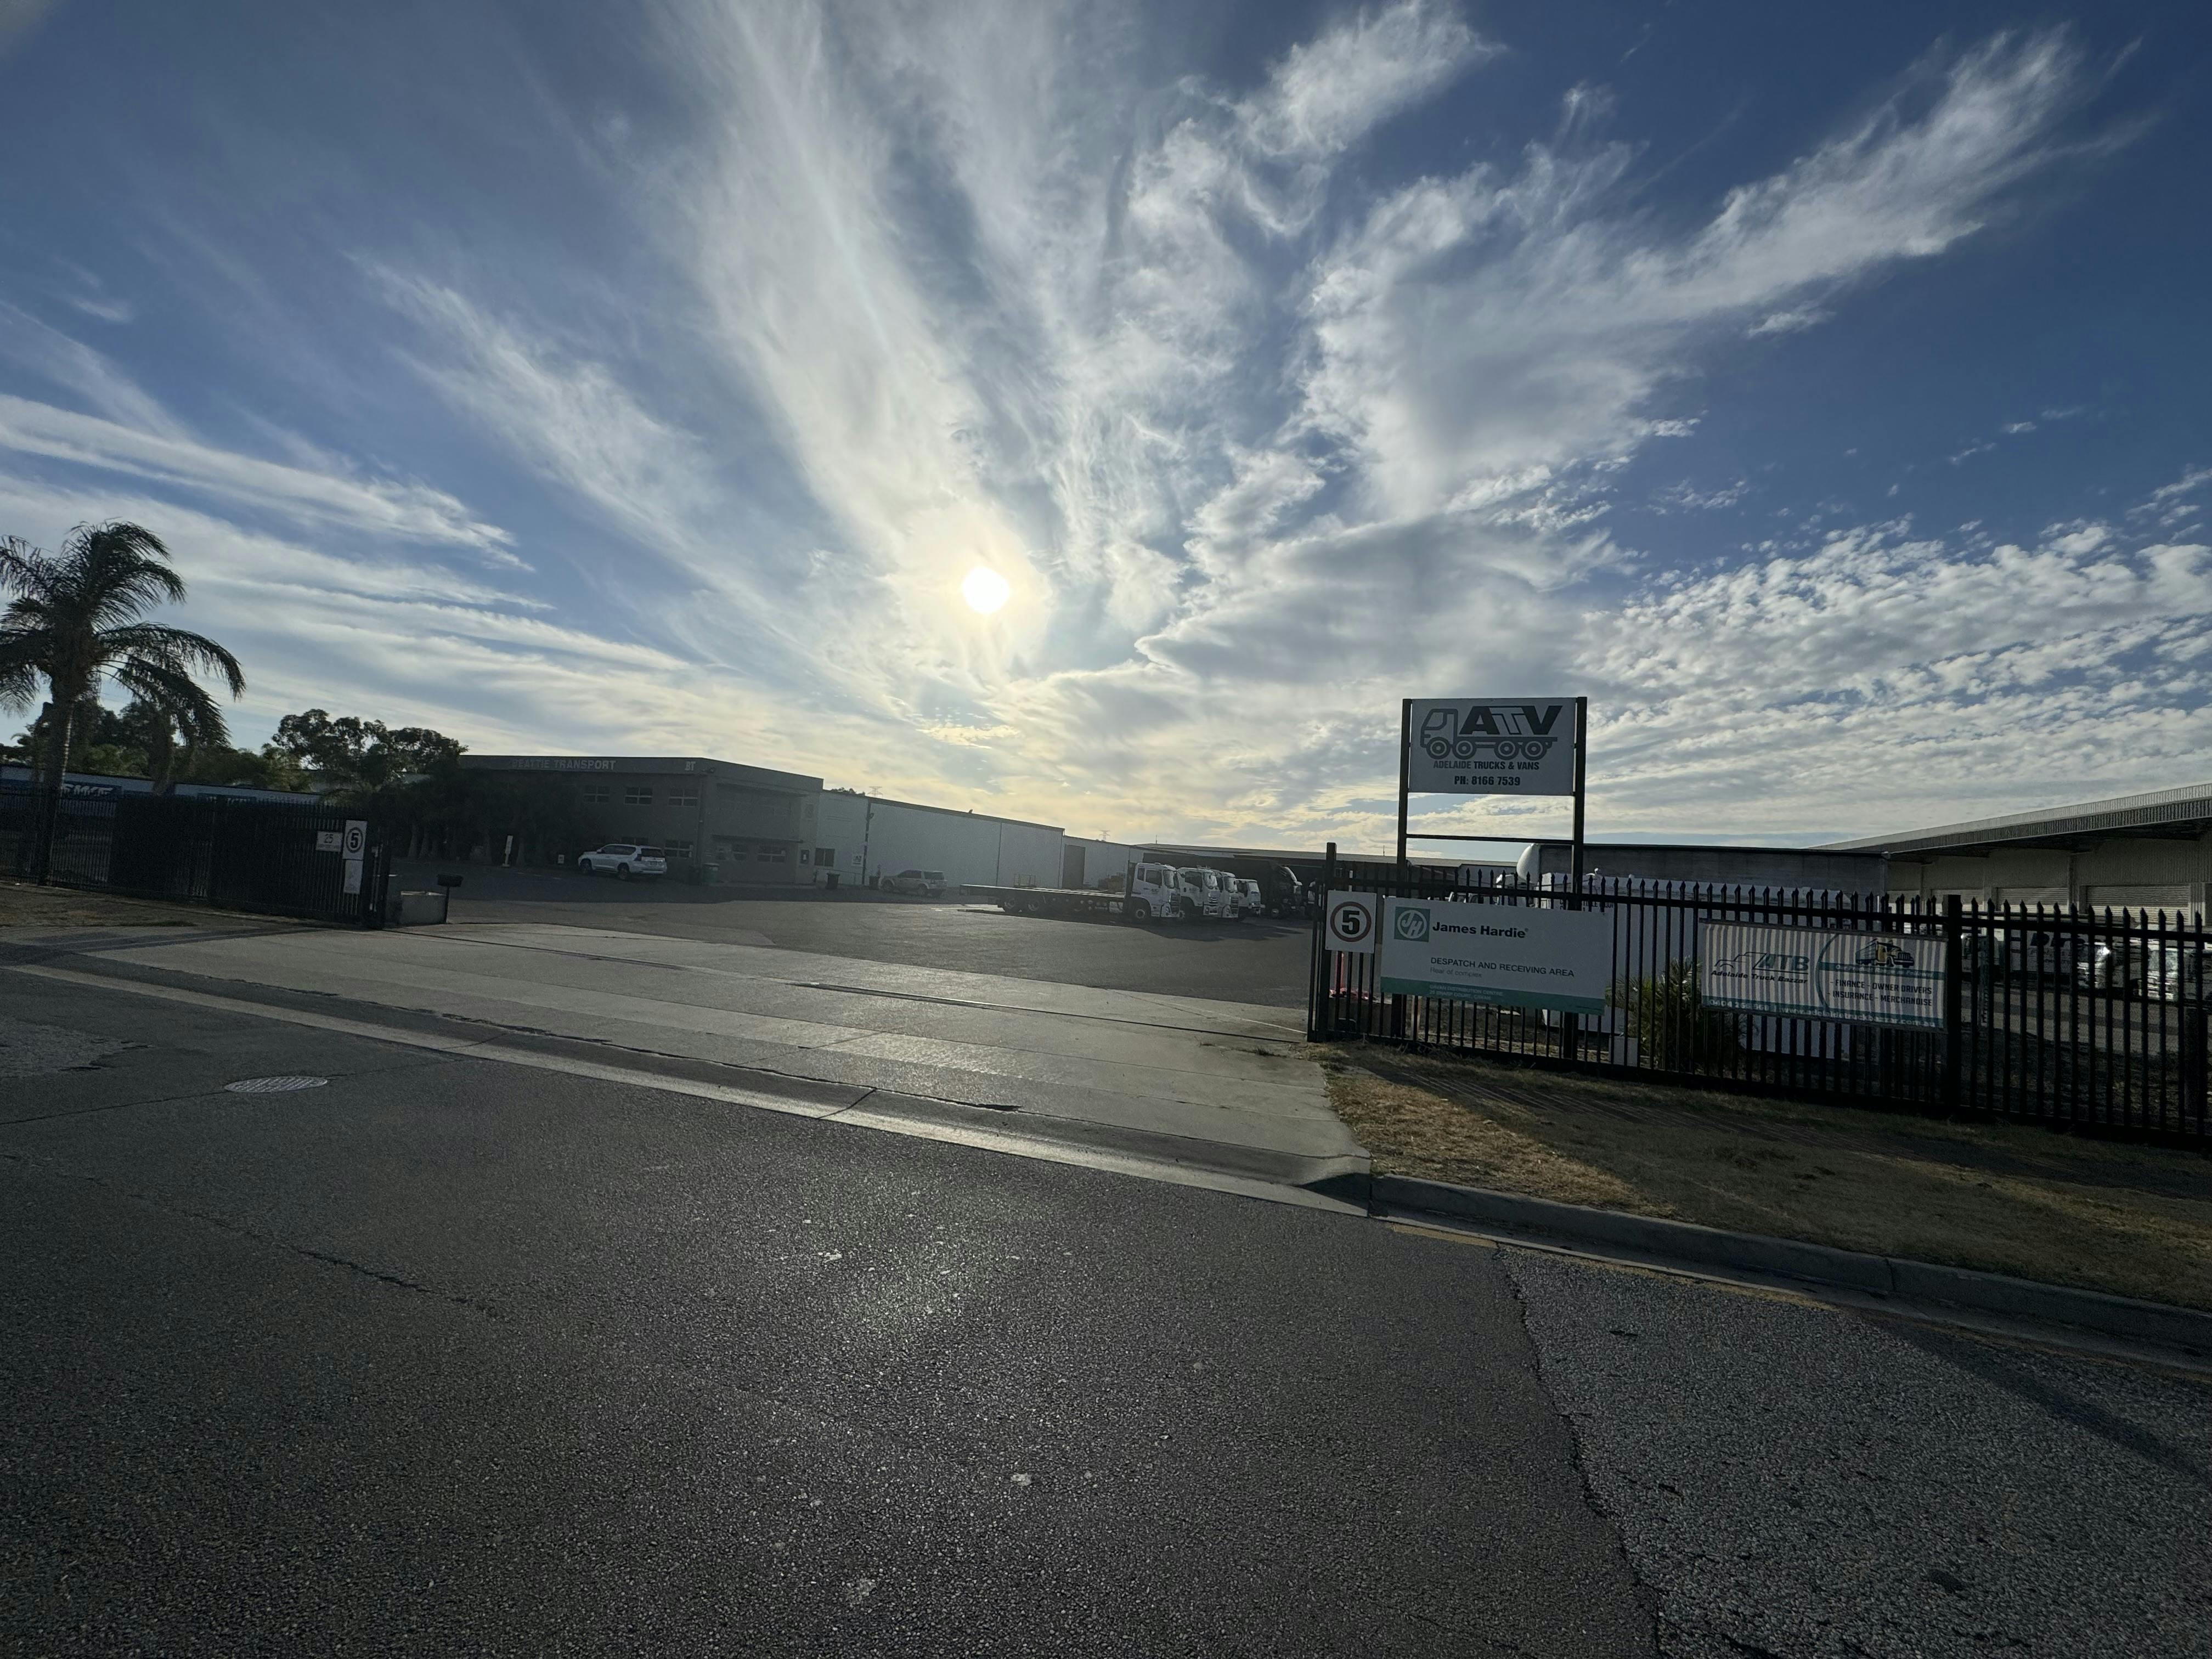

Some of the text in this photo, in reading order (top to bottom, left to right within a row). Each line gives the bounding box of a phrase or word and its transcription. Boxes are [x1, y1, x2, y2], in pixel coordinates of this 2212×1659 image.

[1459, 706, 1563, 735] ATV
[511, 759, 616, 771] BEATTIE TRANSPORT
[1433, 760, 1539, 770] ADELAIDE TRUCKS & VANS
[1454, 776, 1521, 786] PH: 8166 7539
[350, 832, 359, 848] 5
[1342, 910, 1360, 935] 5
[1432, 922, 1476, 934] James
[1431, 957, 1476, 968] DESPATCH
[1499, 963, 1547, 974] RECEIVING
[1549, 968, 1575, 977] AREA
[1758, 953, 1809, 971] ATB
[1455, 970, 1482, 979] complex
[1711, 970, 1748, 979] Adelaide
[1835, 979, 1932, 994] FINANCE OWNER DRIVERS
[1833, 990, 1932, 1006] INSURANCE MERCHANDISE
